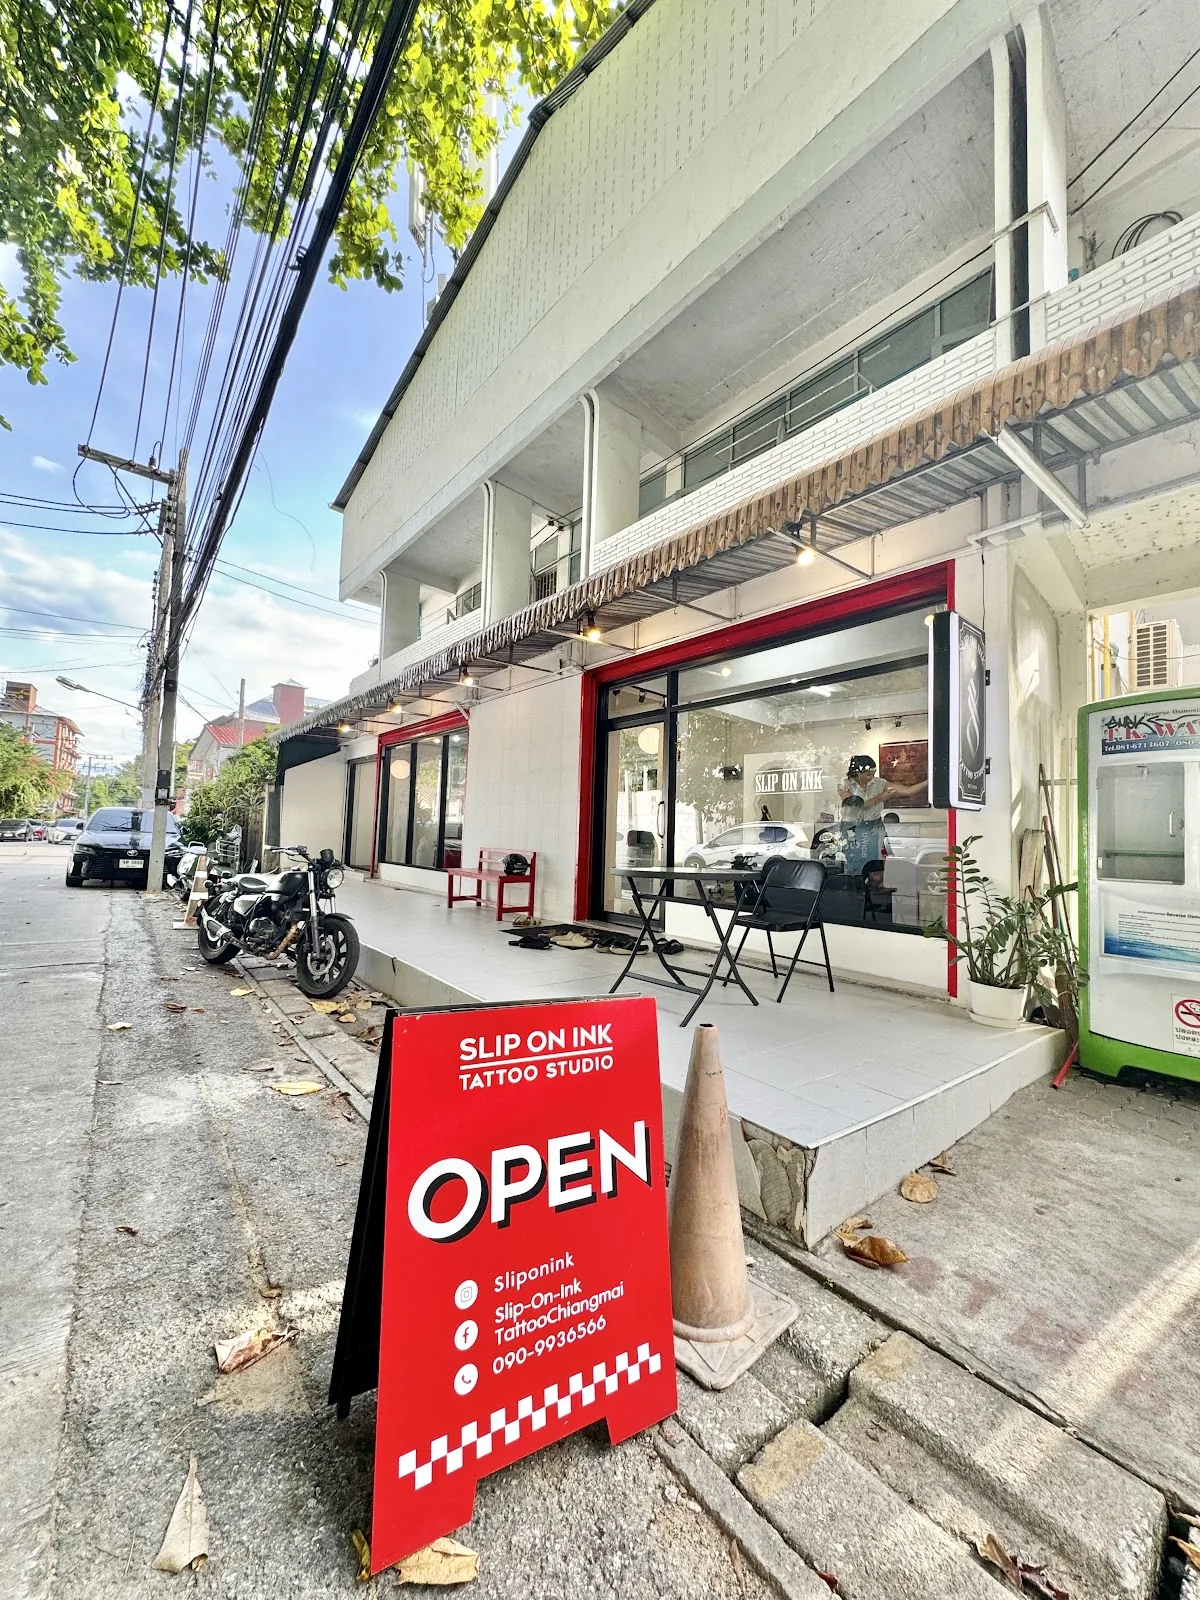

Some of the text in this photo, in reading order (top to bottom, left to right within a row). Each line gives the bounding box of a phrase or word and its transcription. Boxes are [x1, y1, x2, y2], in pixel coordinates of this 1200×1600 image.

[755, 770, 823, 793] SLIP ON INK
[459, 1023, 613, 1061] SLIP ON INK
[459, 1054, 614, 1091] TATTOO STUDIO
[407, 1120, 651, 1241] OPEN
[494, 1251, 575, 1293] Sliponink
[494, 1277, 583, 1323] Slip-On-Ink
[494, 1281, 624, 1345] TattooChiangmai
[492, 1314, 607, 1374] 090-9936566
